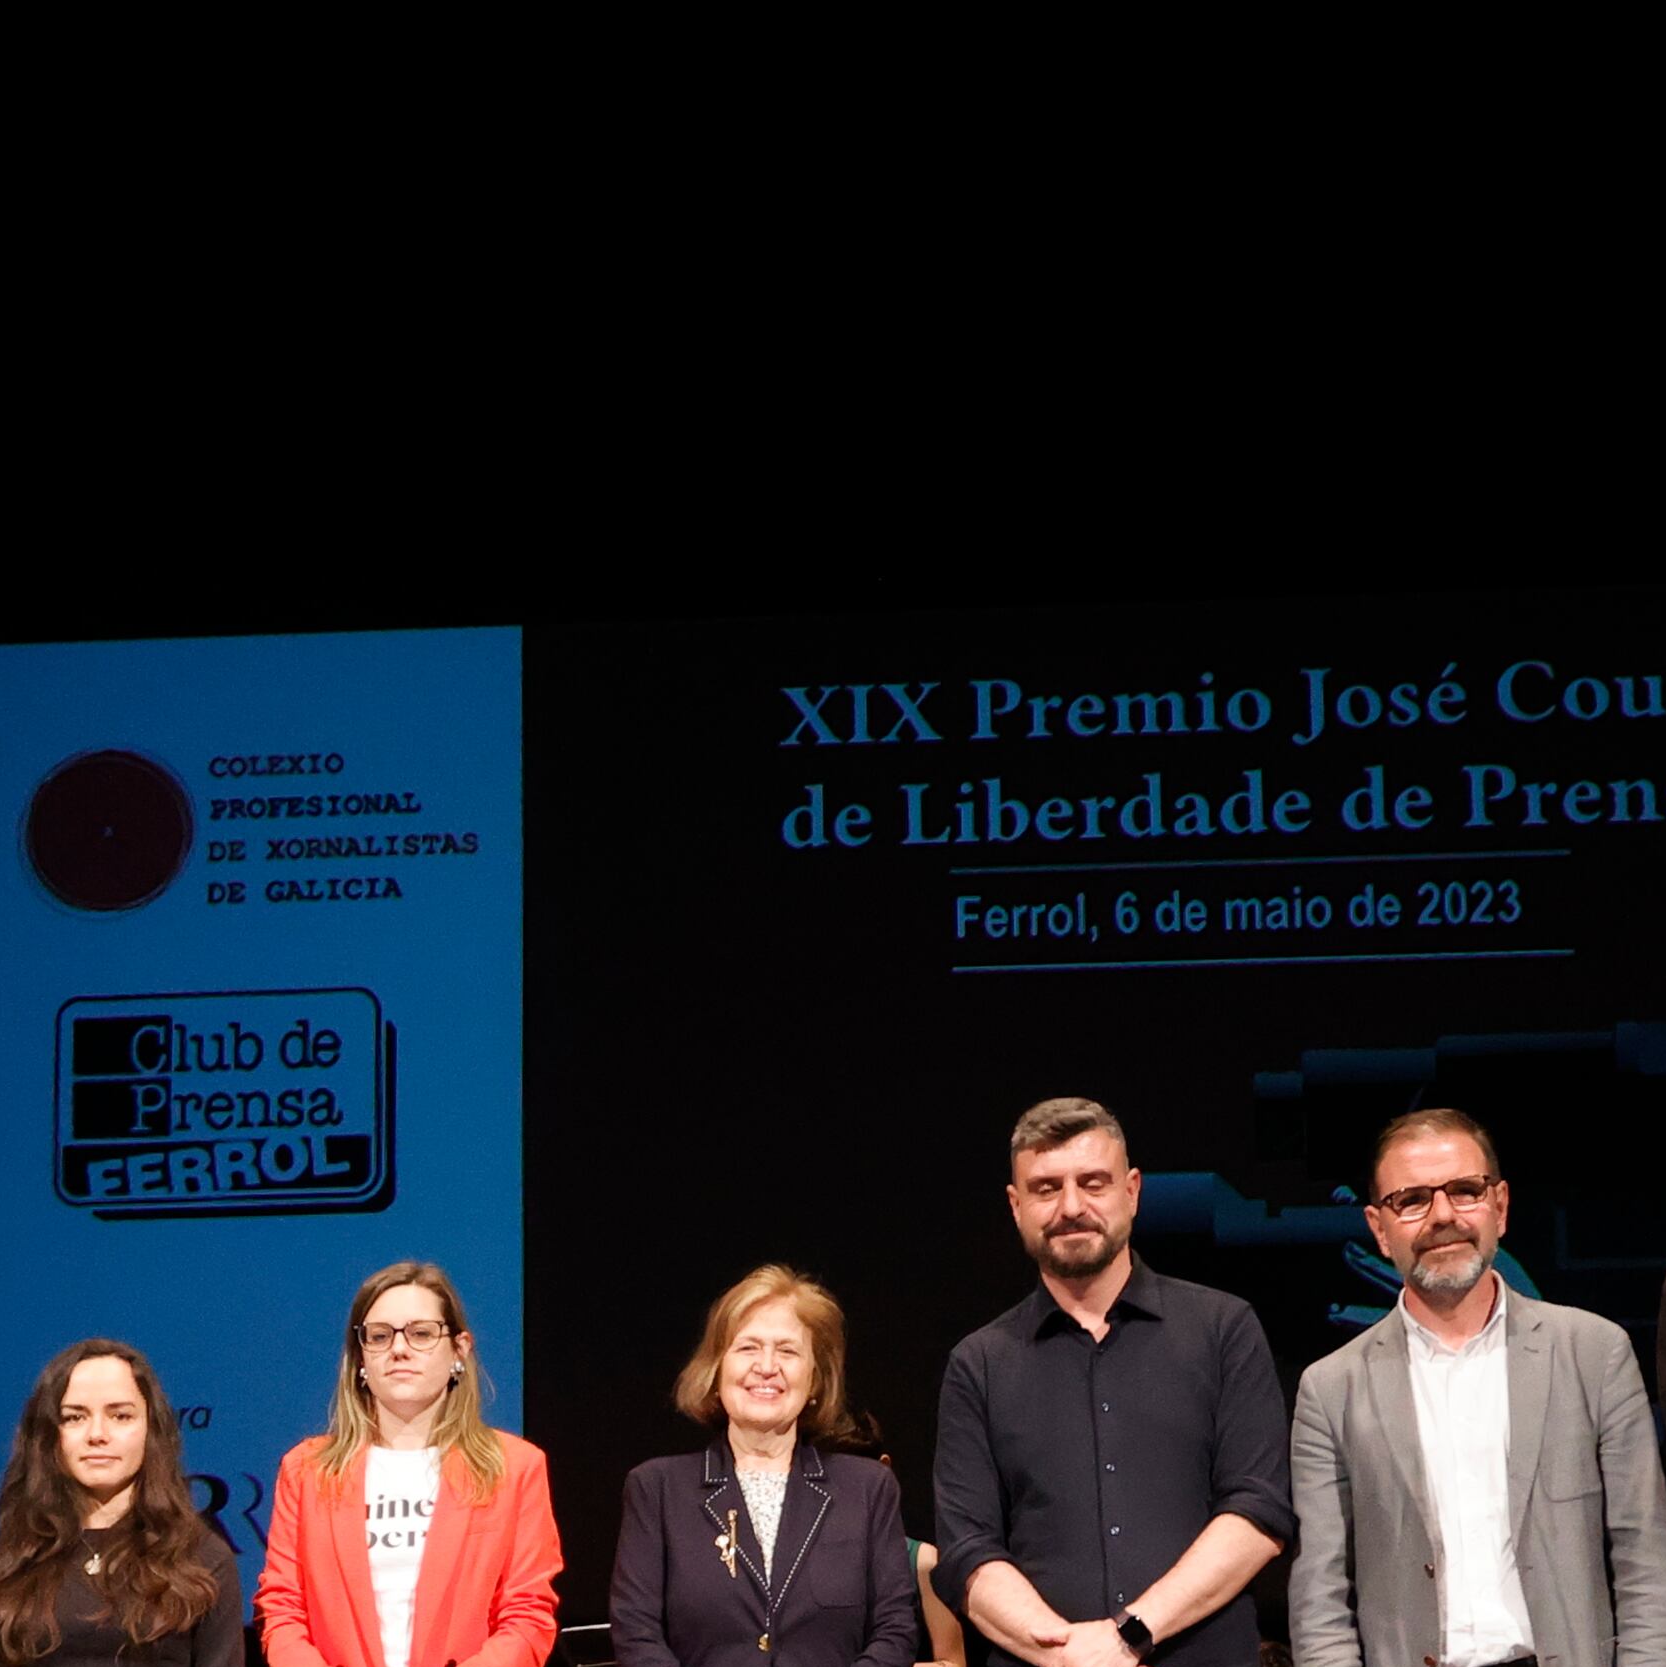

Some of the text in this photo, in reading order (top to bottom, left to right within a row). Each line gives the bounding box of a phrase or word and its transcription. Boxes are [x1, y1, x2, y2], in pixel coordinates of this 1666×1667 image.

[780, 682, 941, 746] XIX
[971, 672, 1271, 740] Premio
[1292, 662, 1465, 746] José
[209, 753, 344, 779] COLEXIO
[209, 793, 422, 821] PROFESIONAL
[781, 784, 872, 849] de
[900, 770, 1311, 845] Liberdade
[1341, 766, 1432, 832] de
[206, 833, 479, 863] DE XORNALISTAS
[206, 878, 402, 906] DE GALICIA
[955, 881, 1522, 942] Ferrol, 6 de maio de 2023
[132, 1018, 343, 1073] Club de
[129, 1083, 344, 1133] Prensa
[87, 1135, 351, 1197] FERROL
